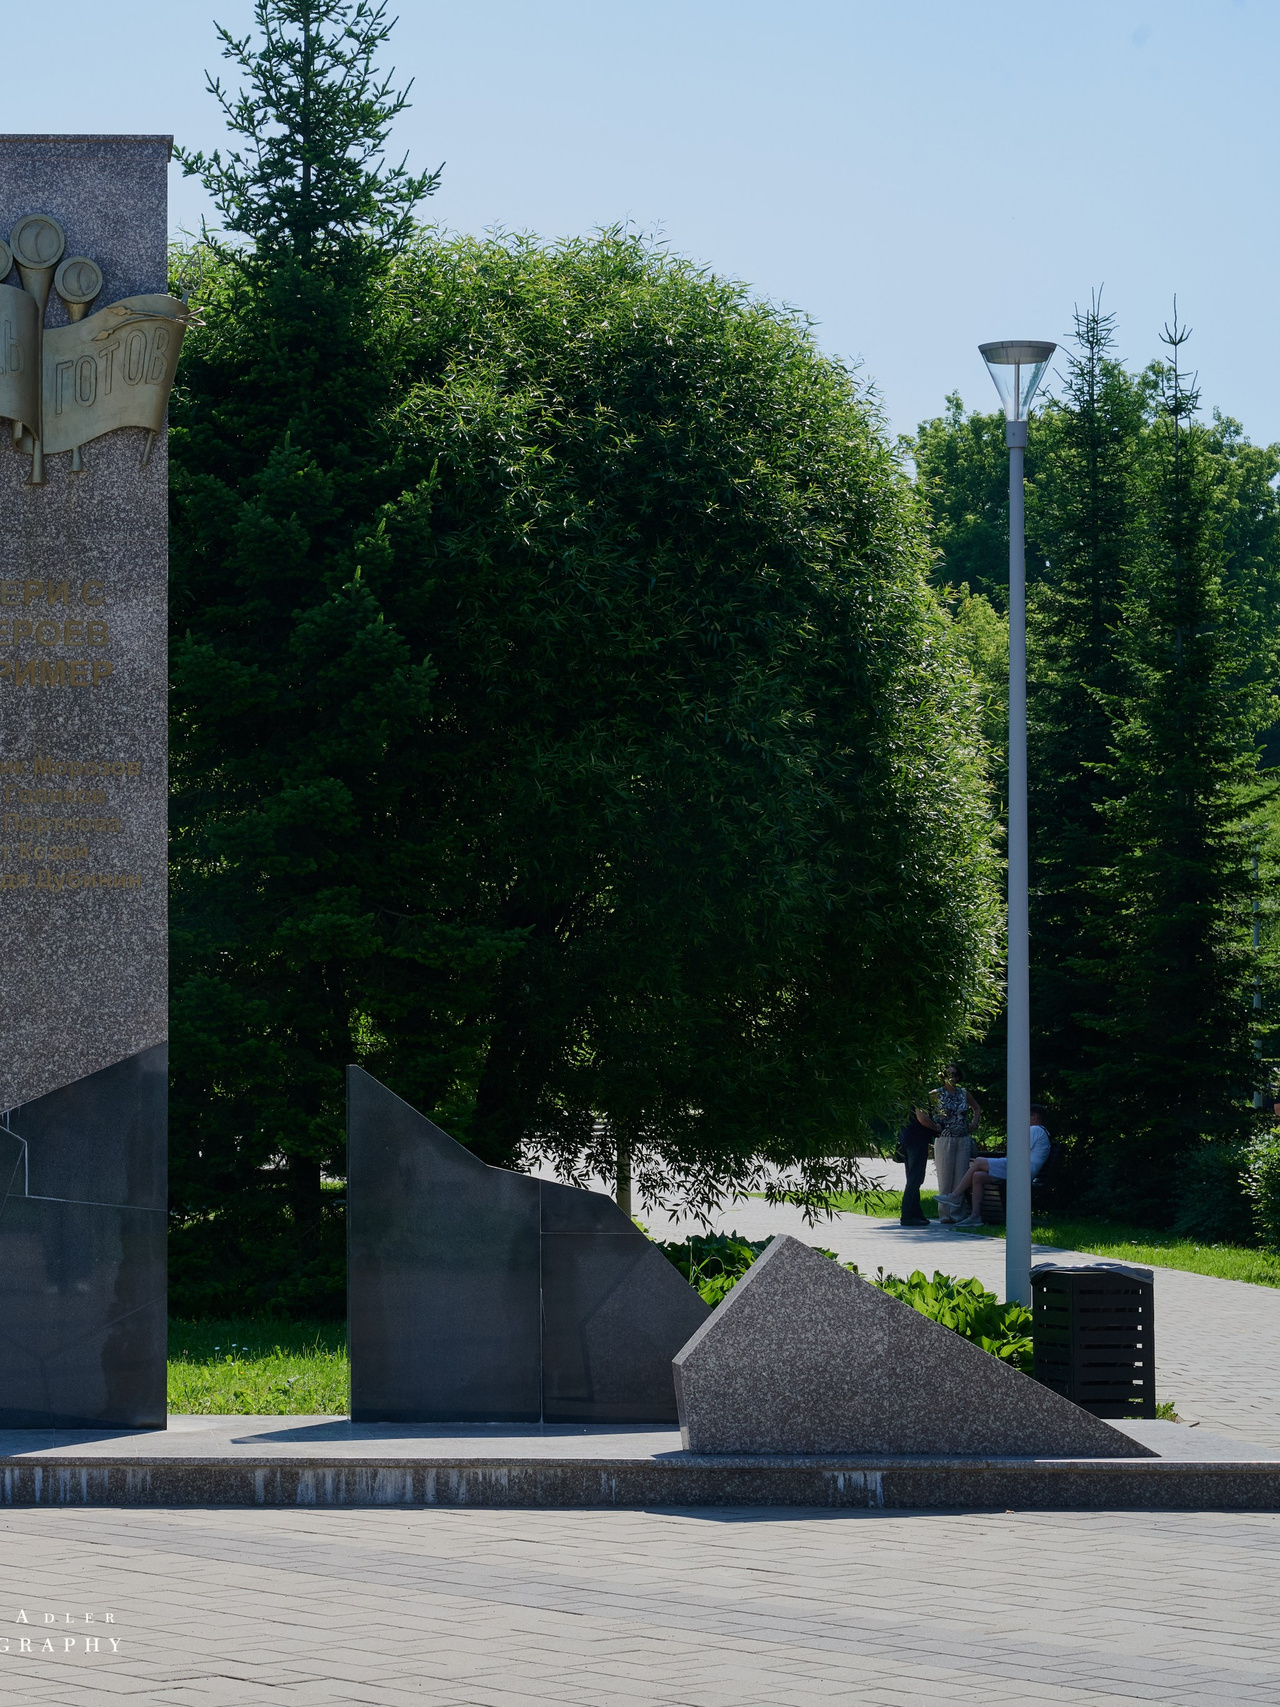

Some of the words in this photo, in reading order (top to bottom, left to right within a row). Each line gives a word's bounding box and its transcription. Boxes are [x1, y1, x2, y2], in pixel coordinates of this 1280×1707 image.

[54, 326, 171, 416] ГОТОВ
[82, 579, 105, 607] С
[33, 756, 141, 779] Морозов
[5, 784, 107, 804] Голиков
[3, 812, 121, 835] Портнова
[34, 869, 142, 893] Дубинин
